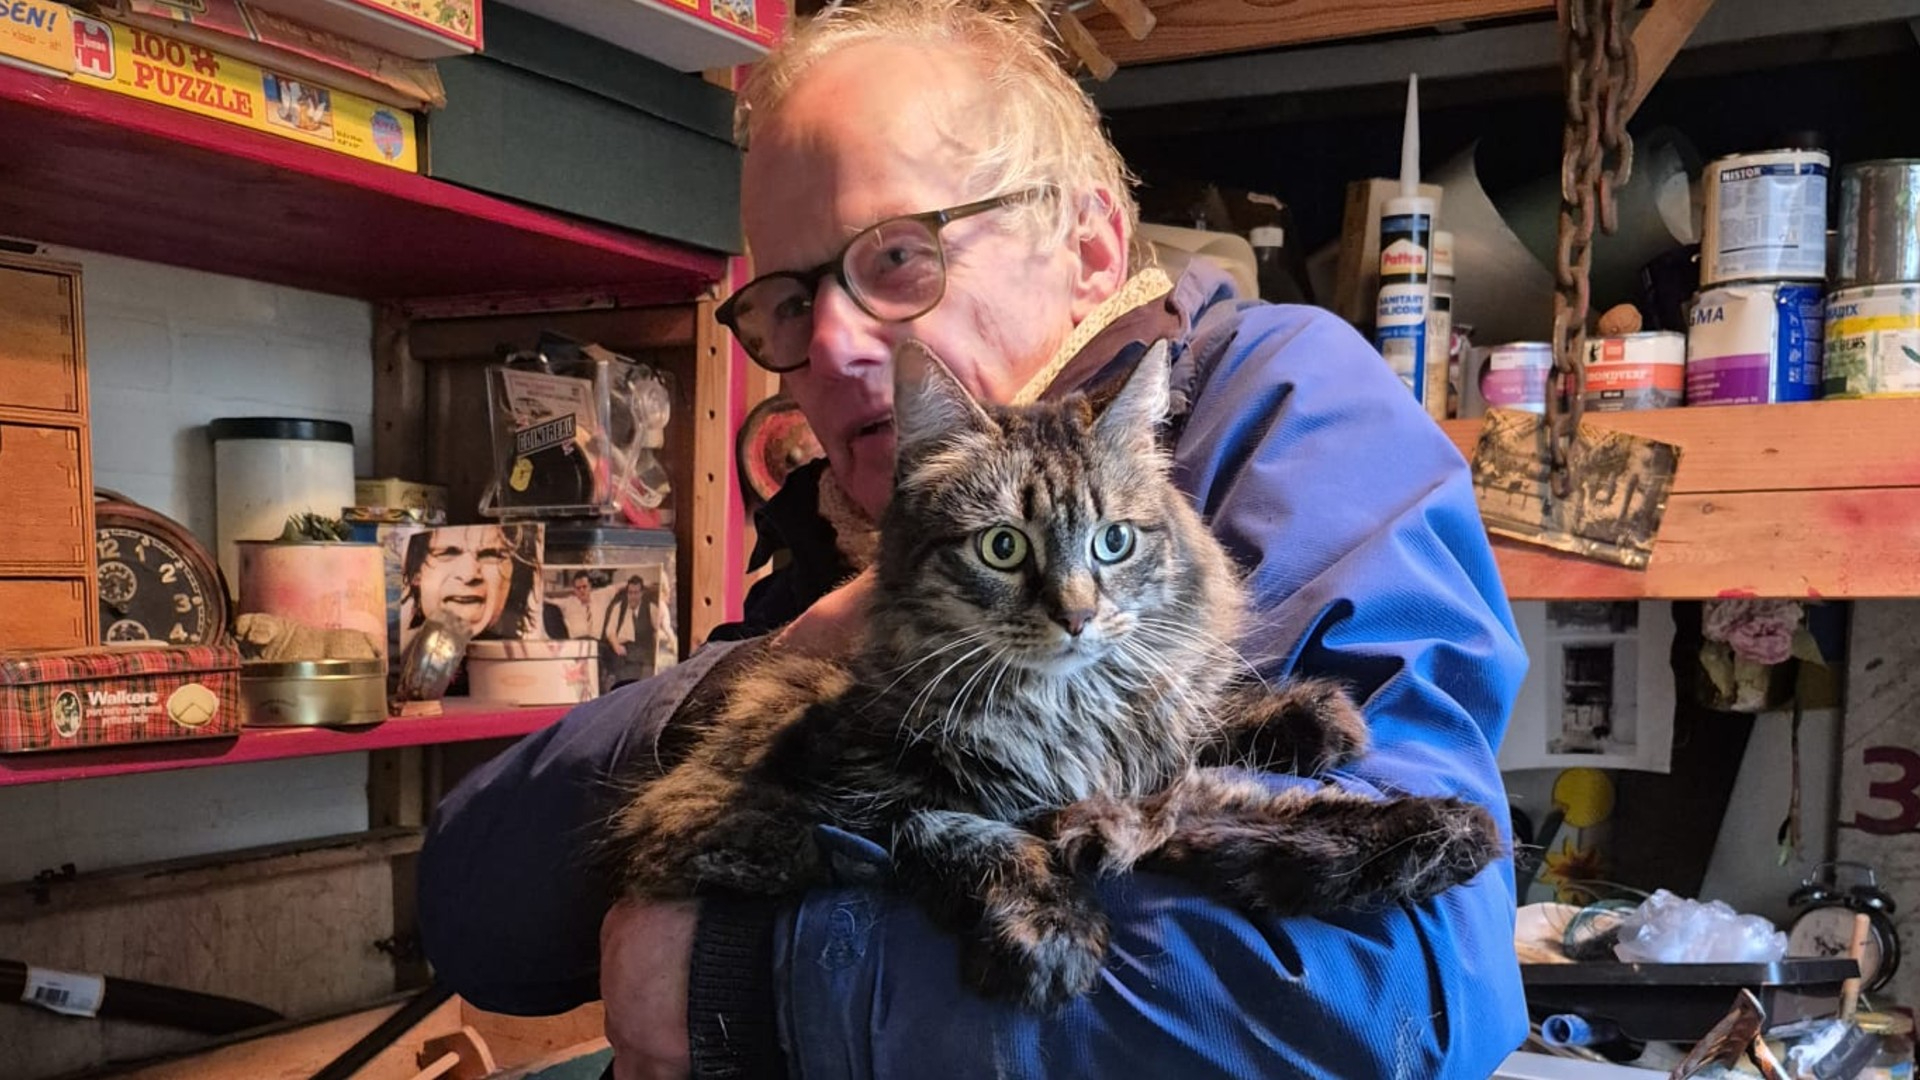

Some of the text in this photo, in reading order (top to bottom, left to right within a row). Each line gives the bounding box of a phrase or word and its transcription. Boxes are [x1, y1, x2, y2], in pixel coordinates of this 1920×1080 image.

[129, 28, 186, 69] 100
[132, 60, 253, 119] PUZZLE
[1721, 166, 1761, 182] HISTOR
[1383, 251, 1424, 266] Pattex
[518, 417, 573, 452] COINTREAU
[97, 539, 120, 559] 12
[134, 543, 146, 564] 1
[158, 562, 178, 584] 2
[173, 593, 192, 613] 3
[169, 622, 188, 642] 4
[87, 689, 158, 707] Walkers
[1855, 746, 1920, 836] 3
